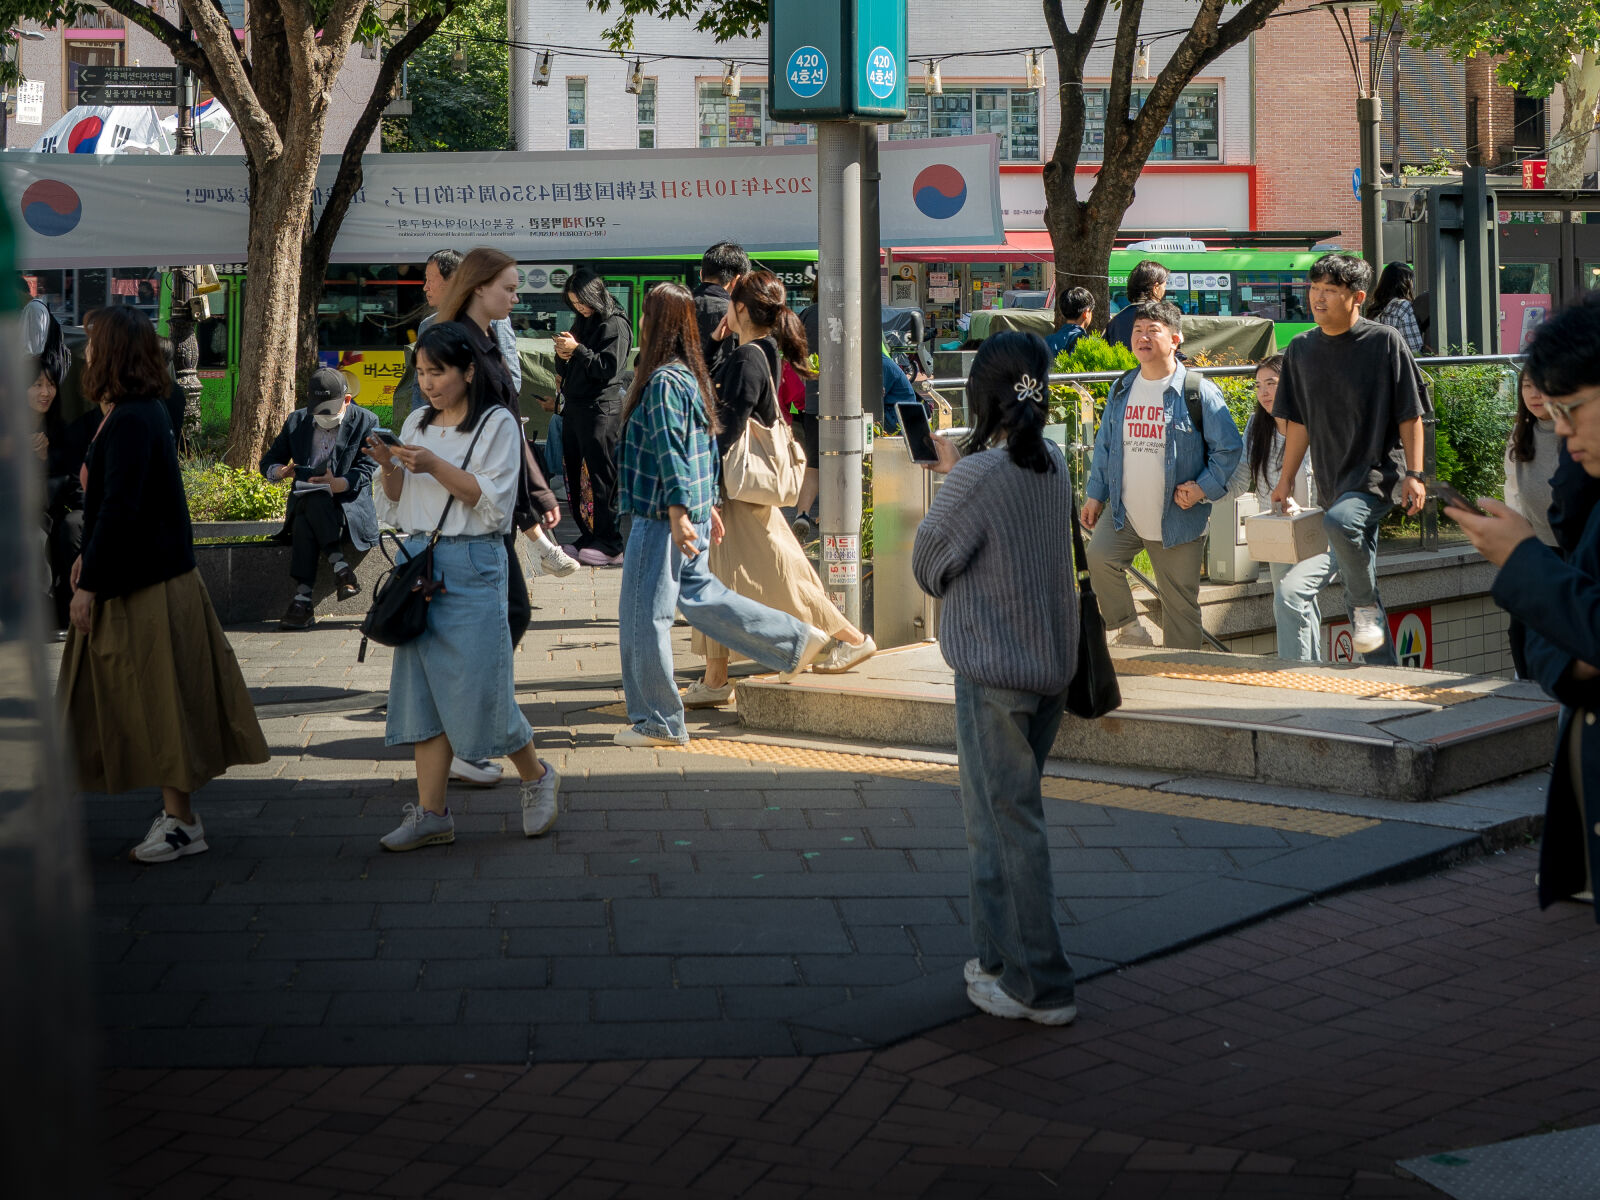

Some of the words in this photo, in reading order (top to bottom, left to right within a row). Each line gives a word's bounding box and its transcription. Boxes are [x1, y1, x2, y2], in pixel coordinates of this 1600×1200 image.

[795, 54, 819, 67] 420
[873, 53, 890, 69] 420
[790, 69, 824, 85] 4호선
[870, 69, 894, 87] 4호선
[1125, 405, 1146, 420] DAY
[1128, 422, 1164, 440] TODAY
